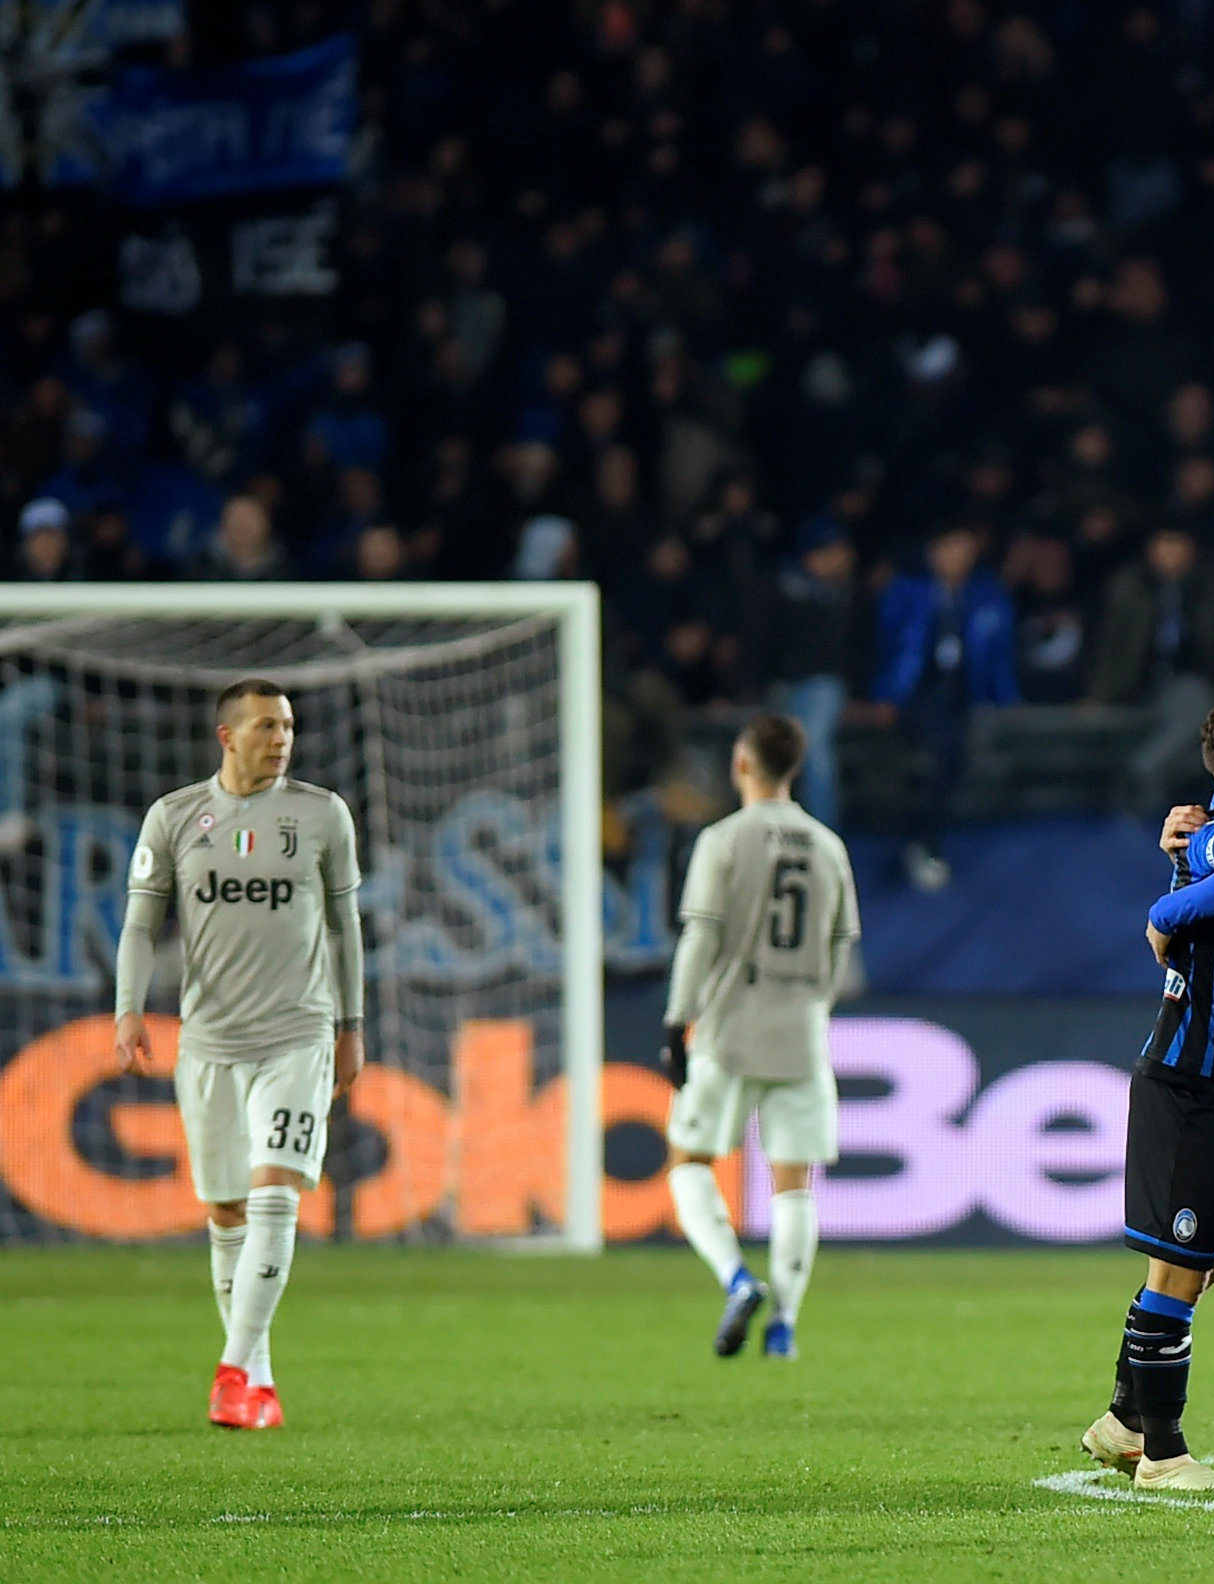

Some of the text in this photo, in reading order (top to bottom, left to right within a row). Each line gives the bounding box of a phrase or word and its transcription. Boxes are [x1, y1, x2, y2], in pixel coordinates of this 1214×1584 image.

[195, 870, 294, 910] Jeep
[770, 857, 808, 949] 5
[267, 1107, 315, 1154] 33
